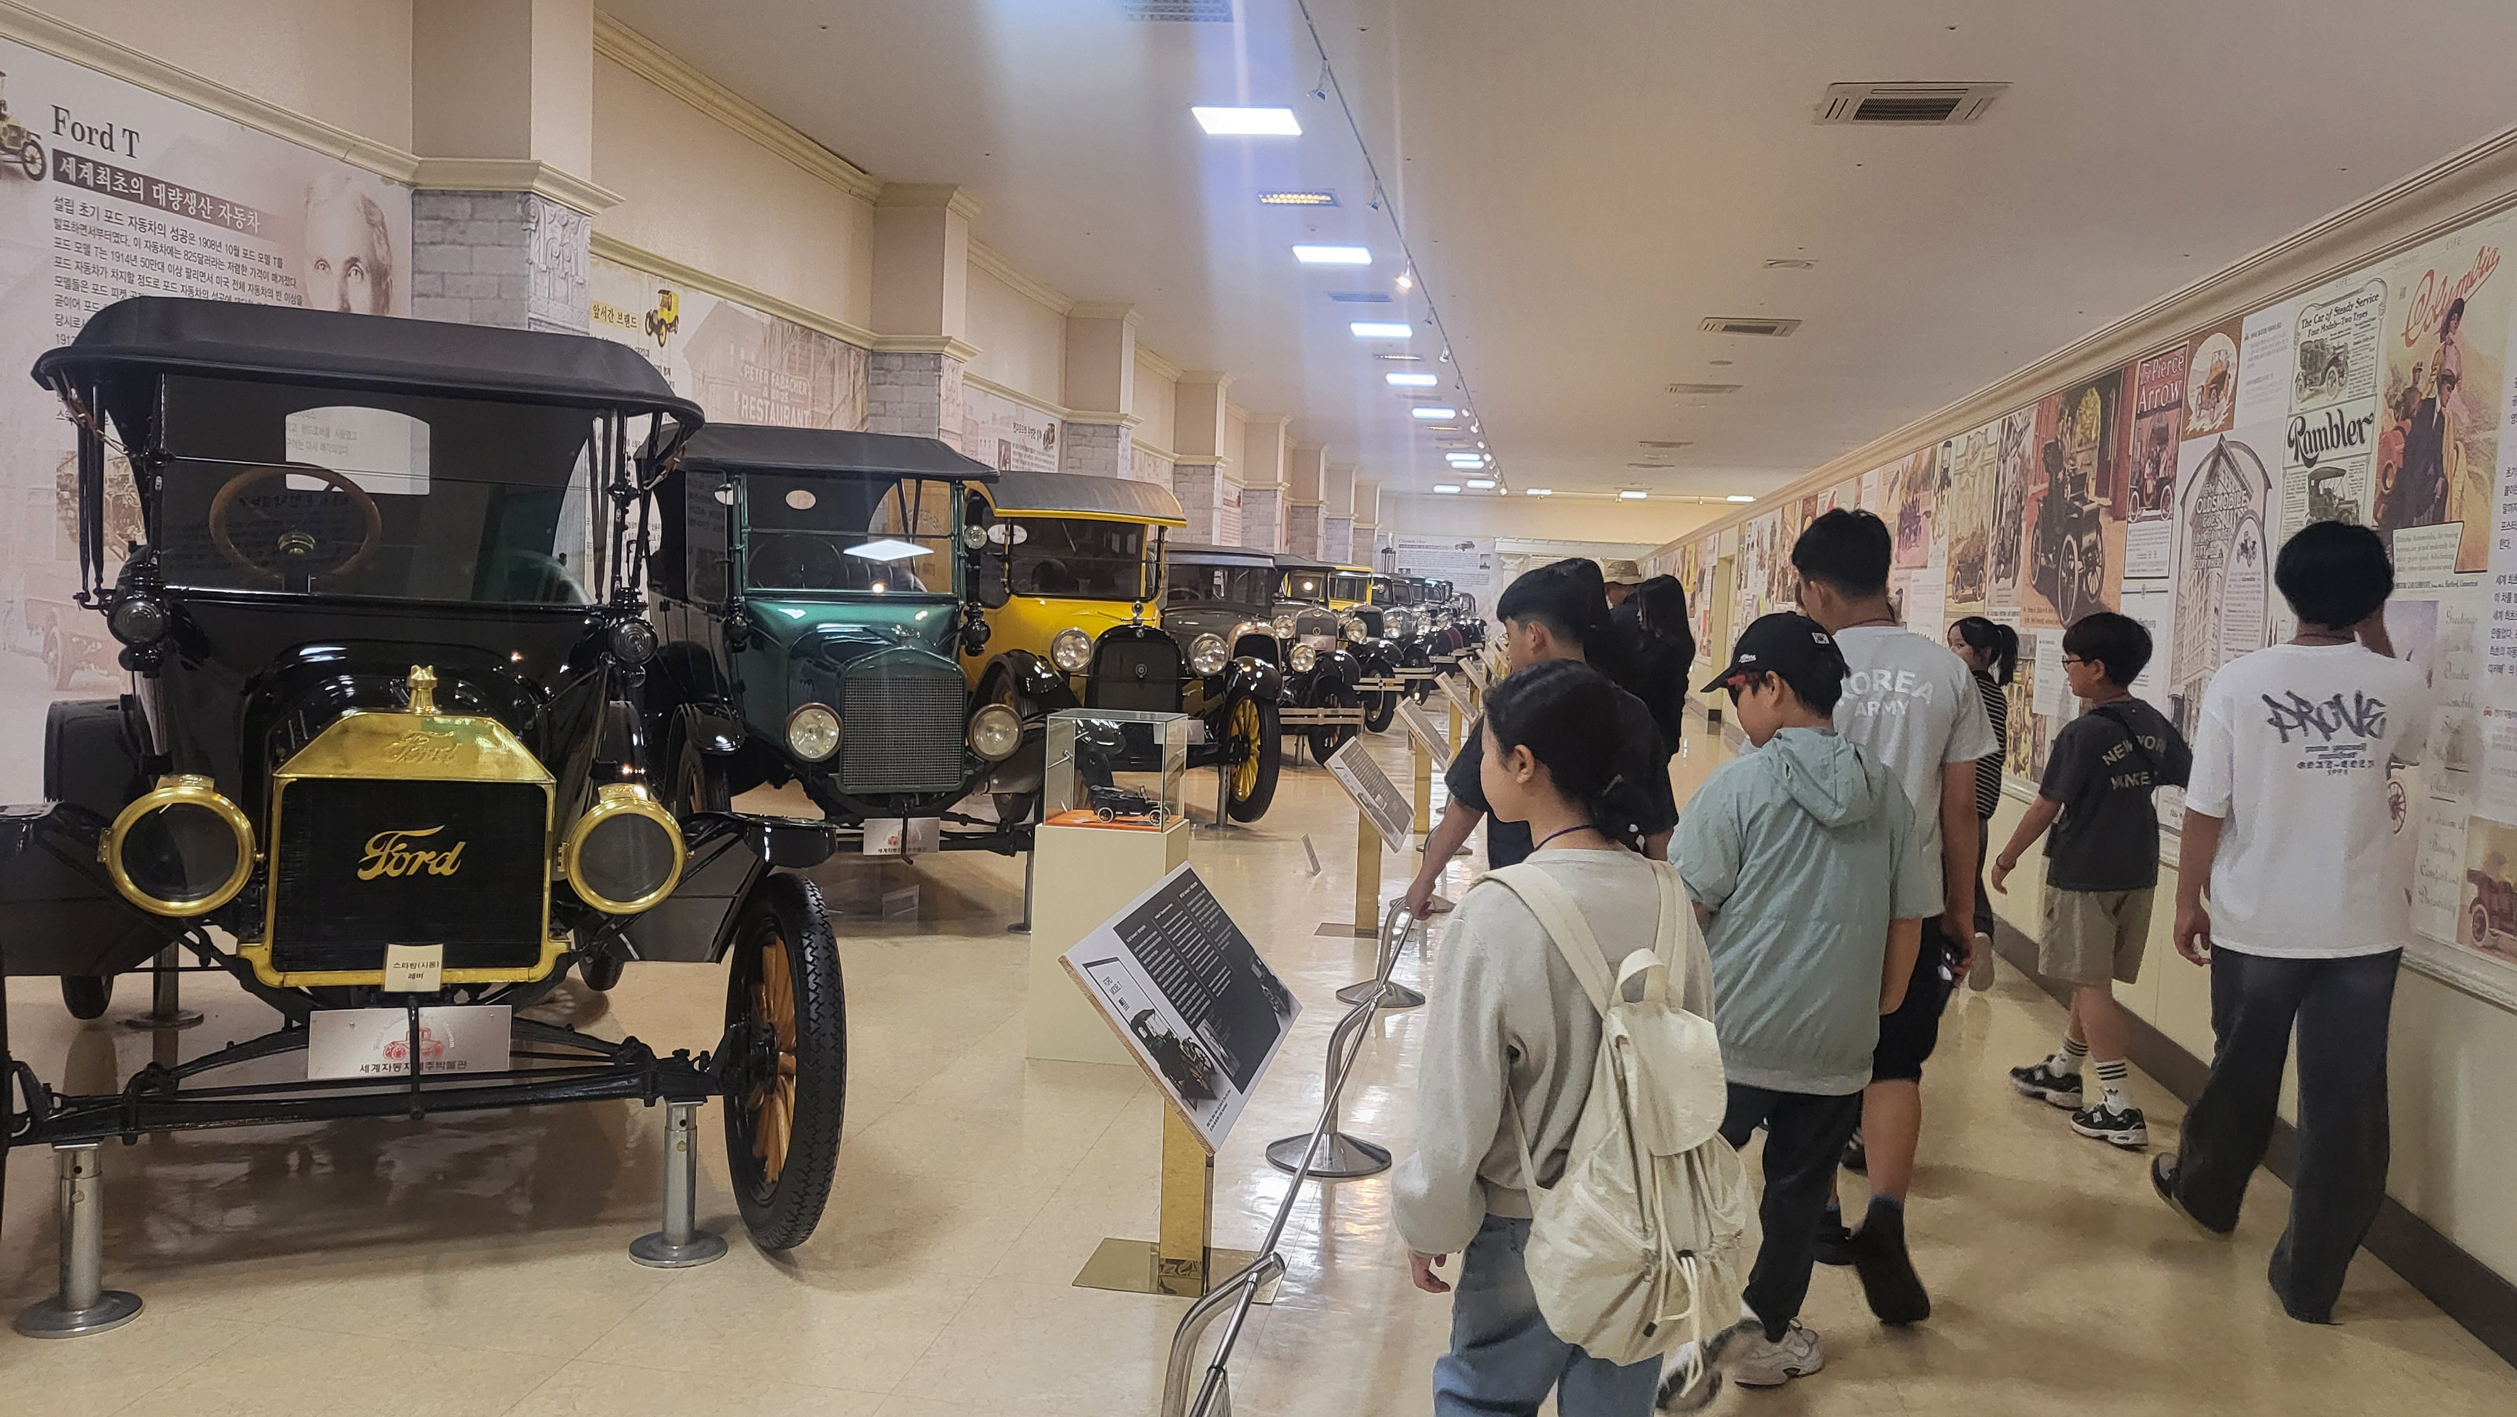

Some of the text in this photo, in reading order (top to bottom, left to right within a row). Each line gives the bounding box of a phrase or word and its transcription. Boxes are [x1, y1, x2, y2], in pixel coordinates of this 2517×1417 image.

[51, 105, 140, 158] Ford T
[59, 156, 260, 233] 세계최초의 대량생산 자동차
[54, 196, 74, 215] 설립
[78, 202, 99, 220] 초기
[104, 209, 124, 226] 포드
[128, 215, 166, 238] 자동차의
[170, 226, 196, 246] 성공은
[199, 236, 222, 252] 1908년
[224, 244, 240, 258] 10월
[242, 248, 256, 260] 포드
[258, 253, 270, 266] 모델
[54, 237, 72, 250] 포드
[74, 242, 91, 256] 모델
[94, 246, 108, 260] T는
[111, 250, 138, 266] 1914년
[140, 258, 164, 272] 50만대
[168, 264, 182, 278] 이상
[216, 276, 229, 288] 미국
[248, 284, 273, 299] 자동차의
[134, 237, 140, 248] 이
[144, 240, 182, 259] 자동차에는
[184, 250, 225, 270] 825달러라는
[228, 262, 247, 276] 저렴한
[250, 268, 269, 282] 가격이
[54, 256, 72, 270] 포드
[74, 260, 108, 279] 자동차가
[111, 268, 134, 284] 차지할
[138, 274, 160, 290] 정도로
[163, 280, 178, 292] 포드
[180, 284, 208, 299] 자동차의
[91, 283, 108, 296] 포드
[84, 300, 100, 312] 포드
[593, 304, 637, 328] 앞서간 브랜드
[2356, 294, 2380, 309] Service
[744, 364, 808, 396] PETER FABACHER
[2152, 355, 2184, 381] Pierce
[742, 394, 812, 428] RESTAURANT
[2137, 380, 2182, 414] Arrow
[2288, 409, 2374, 468] Rambler
[2196, 490, 2248, 514] OLDSMOBILE
[1854, 700, 1910, 718] ARMY
[357, 824, 466, 880] Ford
